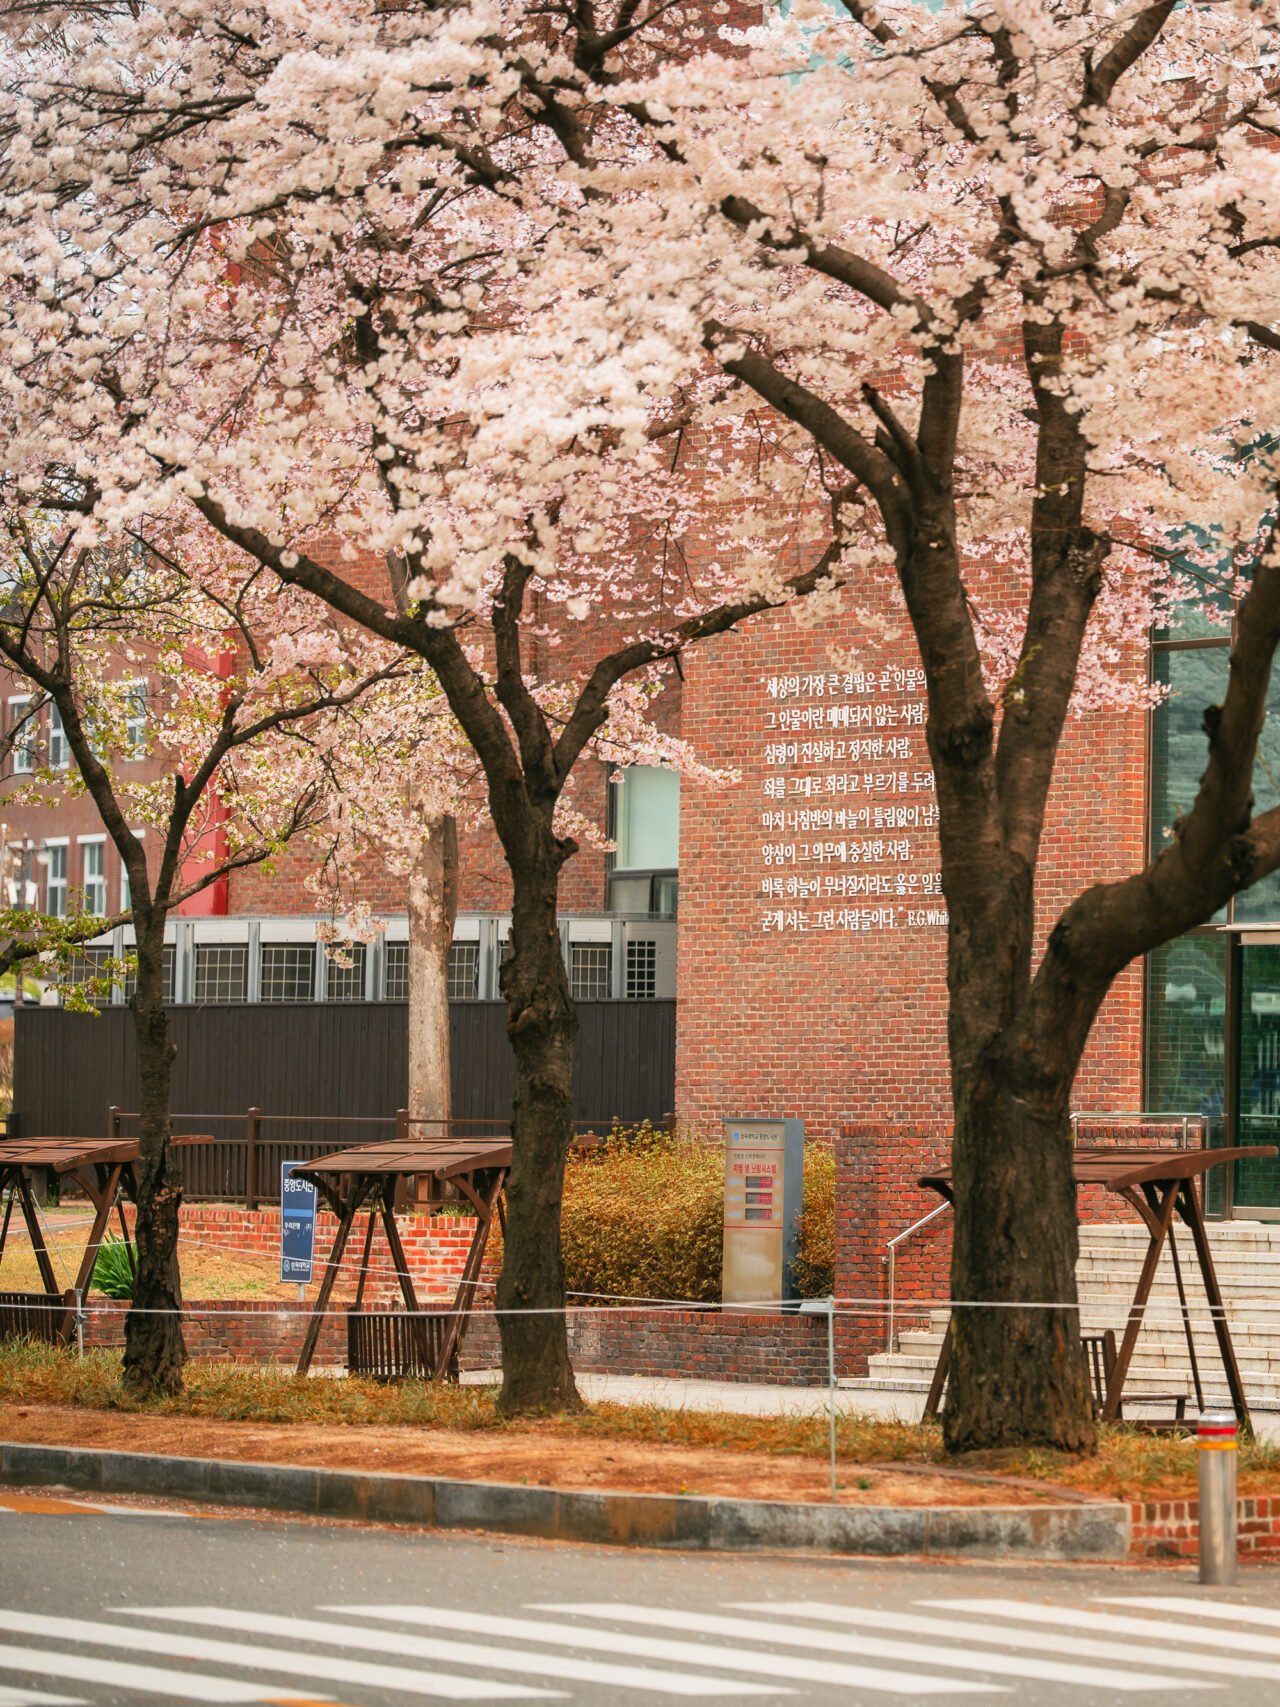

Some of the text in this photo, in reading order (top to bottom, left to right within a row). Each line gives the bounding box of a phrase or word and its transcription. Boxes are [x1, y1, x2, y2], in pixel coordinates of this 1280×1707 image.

[802, 675, 825, 696] 가장
[827, 677, 840, 695] 큰
[843, 672, 877, 694] 결핍은
[879, 671, 891, 692] 곧
[765, 703, 928, 731] 그 인물이란 매매되지 않는 사람,
[765, 737, 913, 764] 심령이 진실하고 정직한 사람,
[763, 770, 936, 799] 죄를 그대로 죄라고 부르기를 두려
[762, 811, 785, 832] 마치
[788, 808, 832, 831] 나침반의
[835, 807, 870, 829] 바늘이
[872, 805, 918, 828] 틀림없이
[762, 839, 914, 865] 양심이 그 의무에 충실한 사람,
[762, 873, 943, 899] 비록 하늘이 무너질지라도 옳은 일을
[761, 910, 783, 932] 굳게
[786, 910, 810, 931] 서는
[811, 909, 834, 930] 그런
